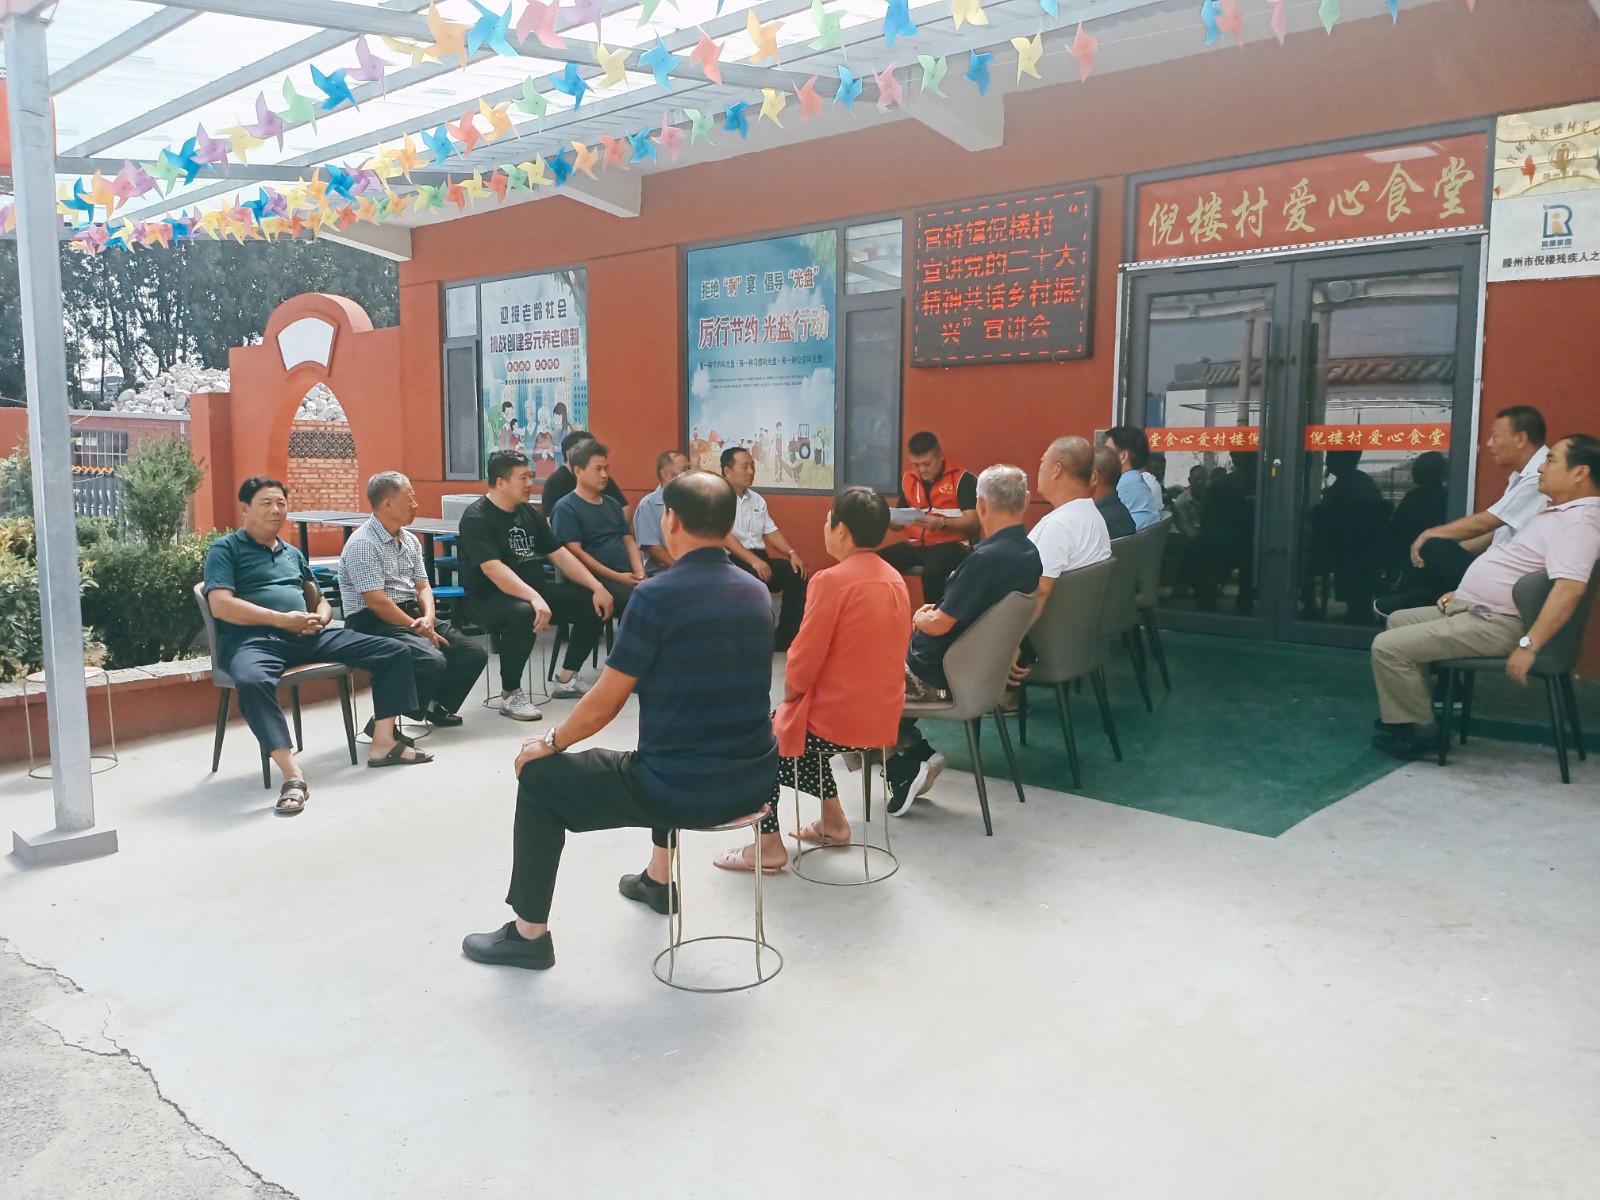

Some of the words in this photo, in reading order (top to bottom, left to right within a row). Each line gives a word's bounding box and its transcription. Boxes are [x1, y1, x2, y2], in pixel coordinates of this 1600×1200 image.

[1148, 156, 1475, 247] 倪楼村爱心食堂
[922, 243, 1077, 283] 宣讲党的二十大
[1502, 250, 1600, 269] 滕州市倪楼残疾人之
[922, 277, 1081, 316] 精神共话乡村振
[500, 298, 567, 324] 迎接老龄社会
[490, 327, 579, 353] 挑战创建多元养老体制
[1309, 428, 1446, 446] 倪楼村爱心食堂
